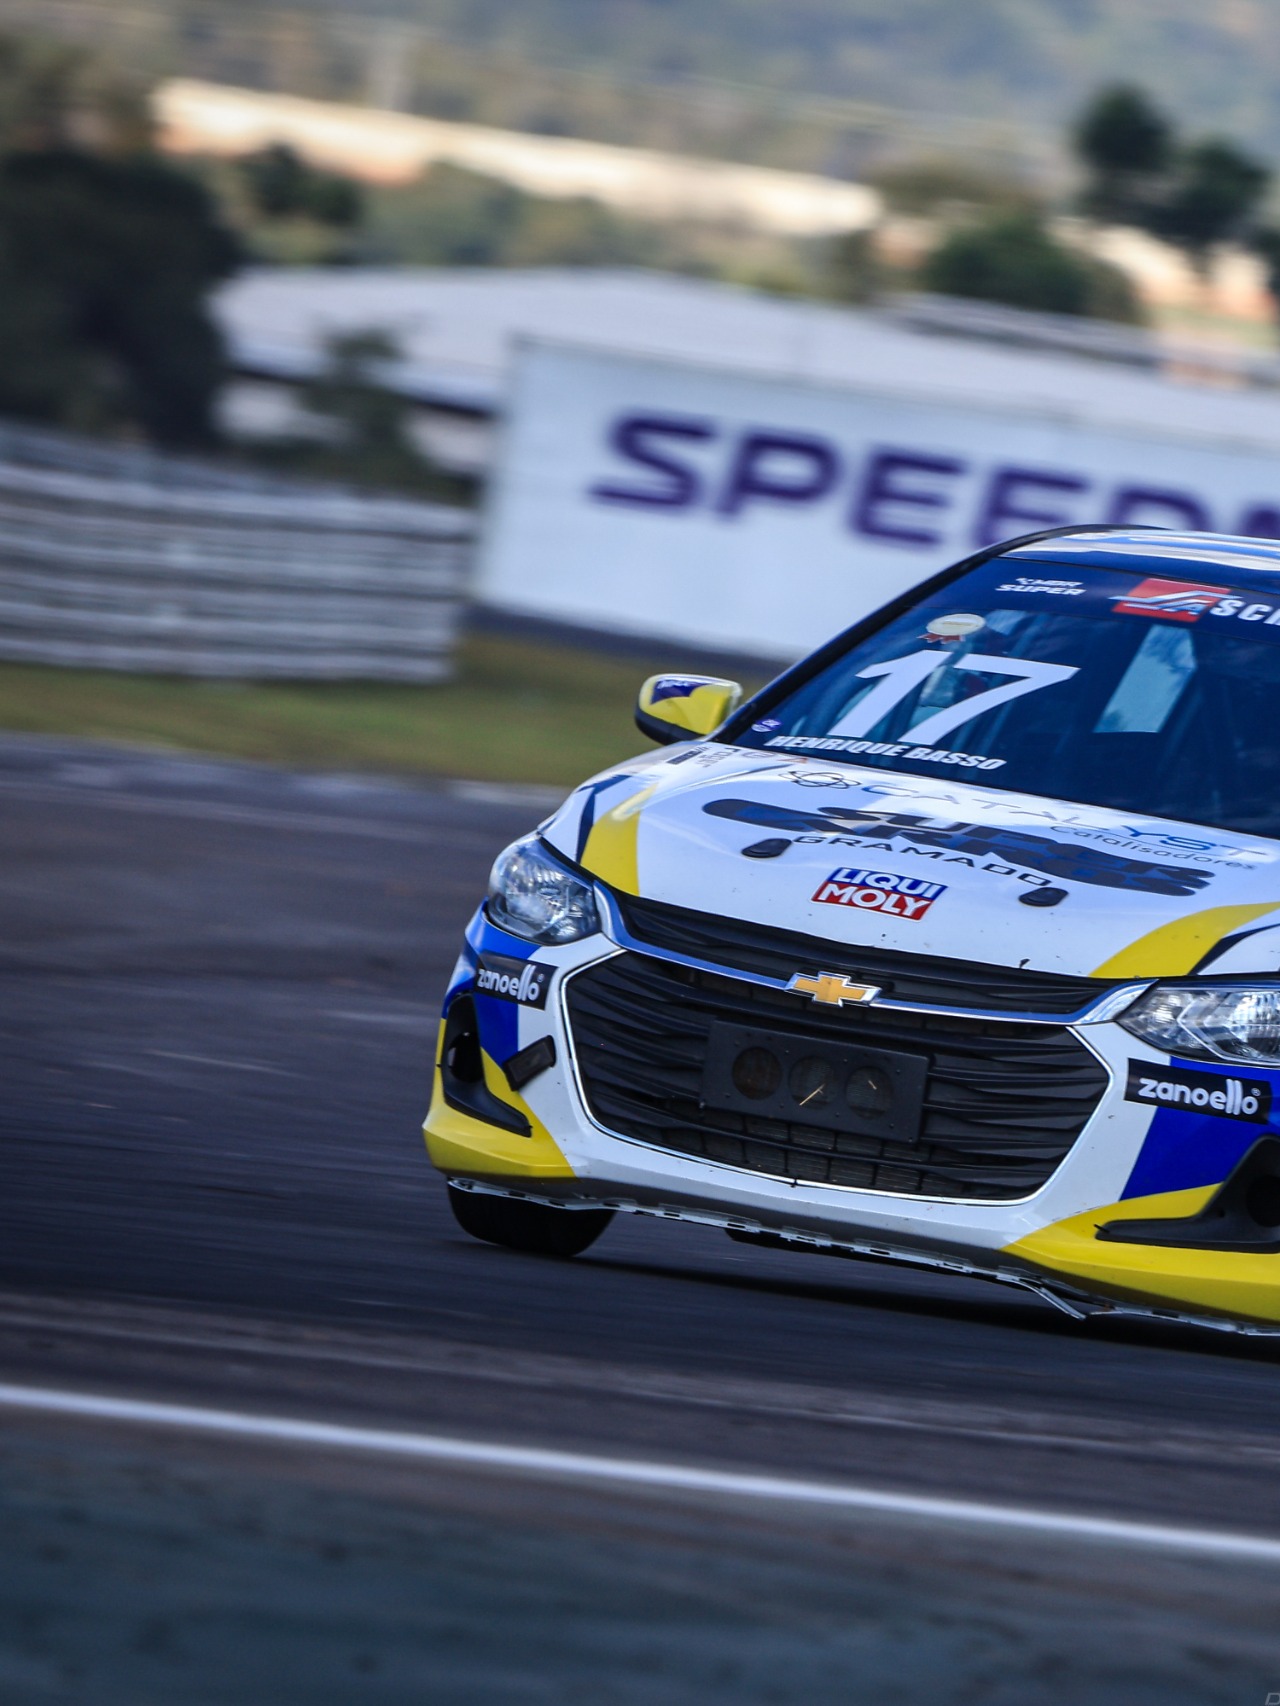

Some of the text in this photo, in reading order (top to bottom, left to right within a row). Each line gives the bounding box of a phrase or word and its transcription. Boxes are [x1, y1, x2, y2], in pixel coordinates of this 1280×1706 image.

[995, 584, 1086, 596] SUPER
[828, 649, 1081, 746] 17
[764, 735, 910, 757] HENRIQUE
[902, 747, 1008, 771] BASSO
[861, 785, 1270, 856] CATALYST
[792, 835, 1053, 887] GRAMADO
[1051, 825, 1257, 871] Catalisadores
[817, 884, 932, 917] MOLY
[831, 868, 945, 898] LIQUI
[477, 964, 540, 1001] zanoello
[1138, 1078, 1259, 1116] zanoello
